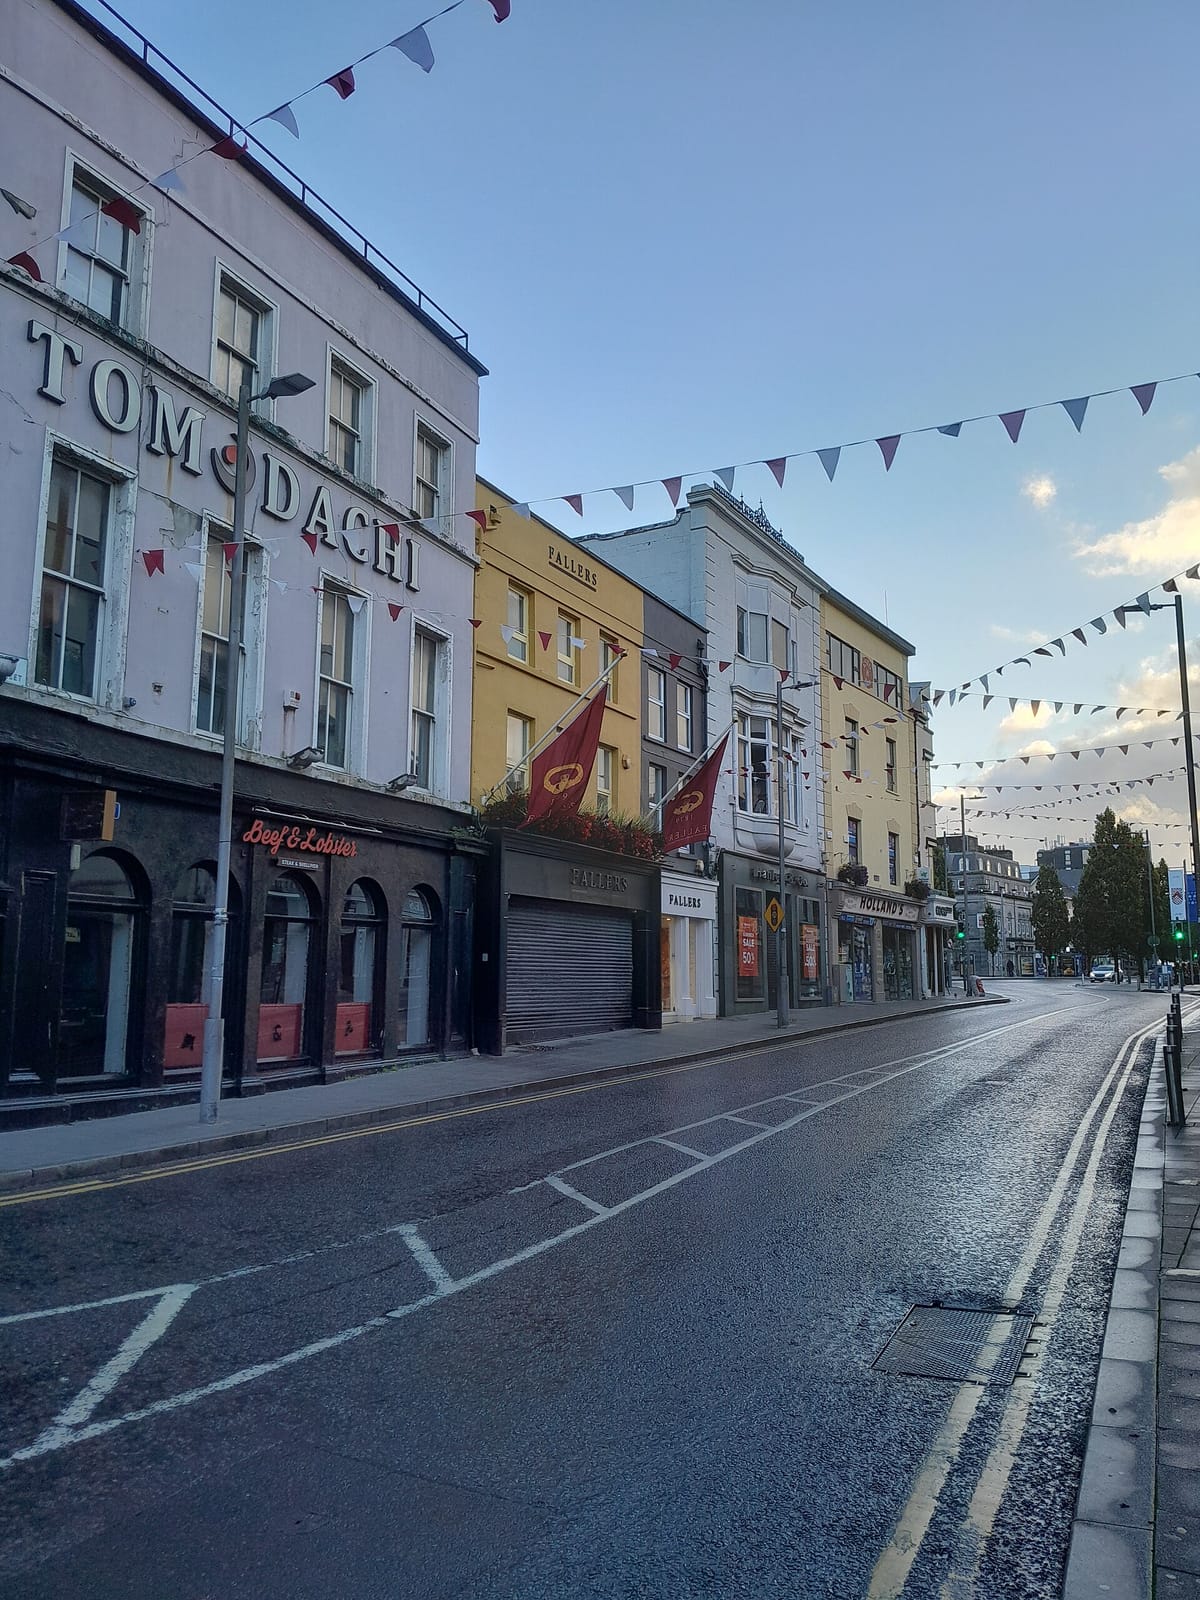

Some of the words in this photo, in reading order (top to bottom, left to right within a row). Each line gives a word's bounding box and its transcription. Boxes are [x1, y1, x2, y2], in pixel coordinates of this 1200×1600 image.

[548, 545, 597, 586] FALLERS
[242, 819, 289, 856] Beef
[287, 826, 301, 848] &
[300, 827, 358, 857] Lobster
[571, 868, 629, 893] FALLERS
[669, 894, 702, 908] FALLERS
[860, 896, 904, 915] HOLLAND'S
